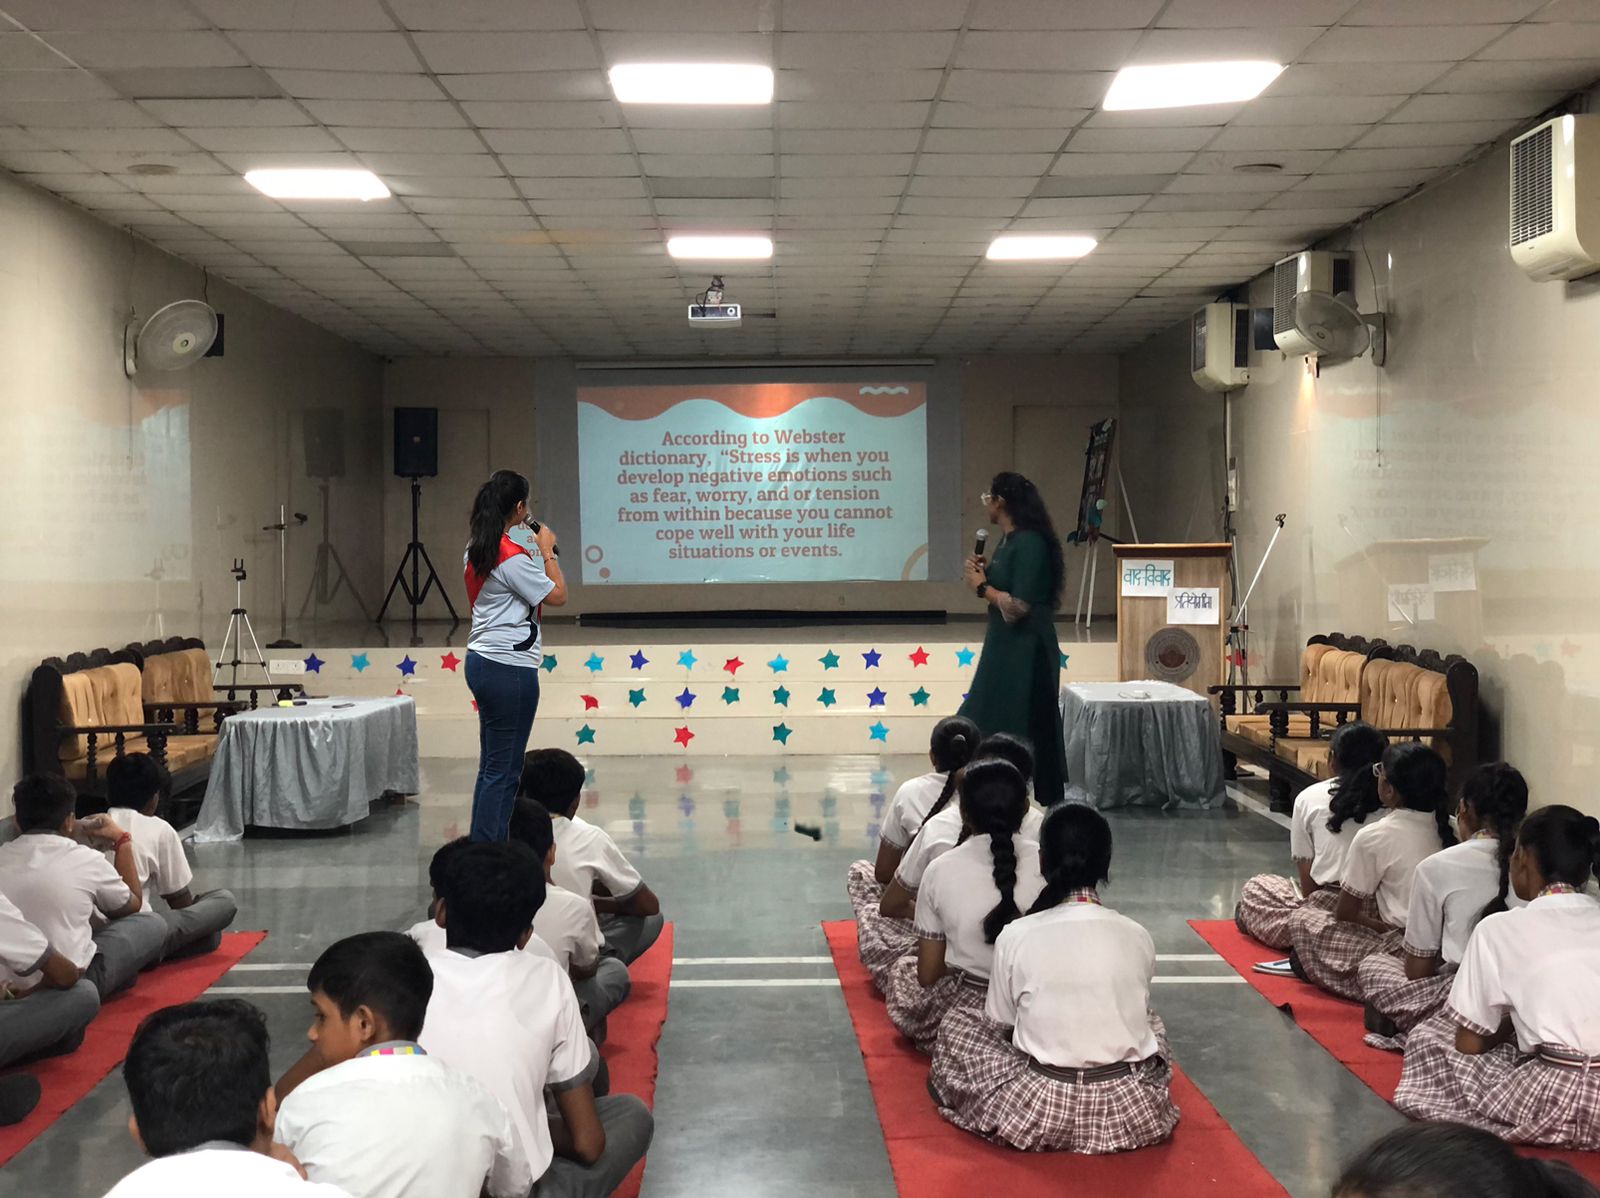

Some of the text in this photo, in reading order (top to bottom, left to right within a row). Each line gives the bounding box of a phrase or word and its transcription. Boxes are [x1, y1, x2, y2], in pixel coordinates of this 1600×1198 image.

[662, 429, 845, 448] According to Webster
[619, 448, 889, 467] dictionary, “Stress is when you
[618, 467, 892, 487] develop negative emotions such
[630, 487, 880, 505] as fear, worry, and or tension
[618, 506, 893, 524] from within because you cannot
[656, 524, 855, 543] cope well with your life
[669, 544, 842, 559] situations or events.
